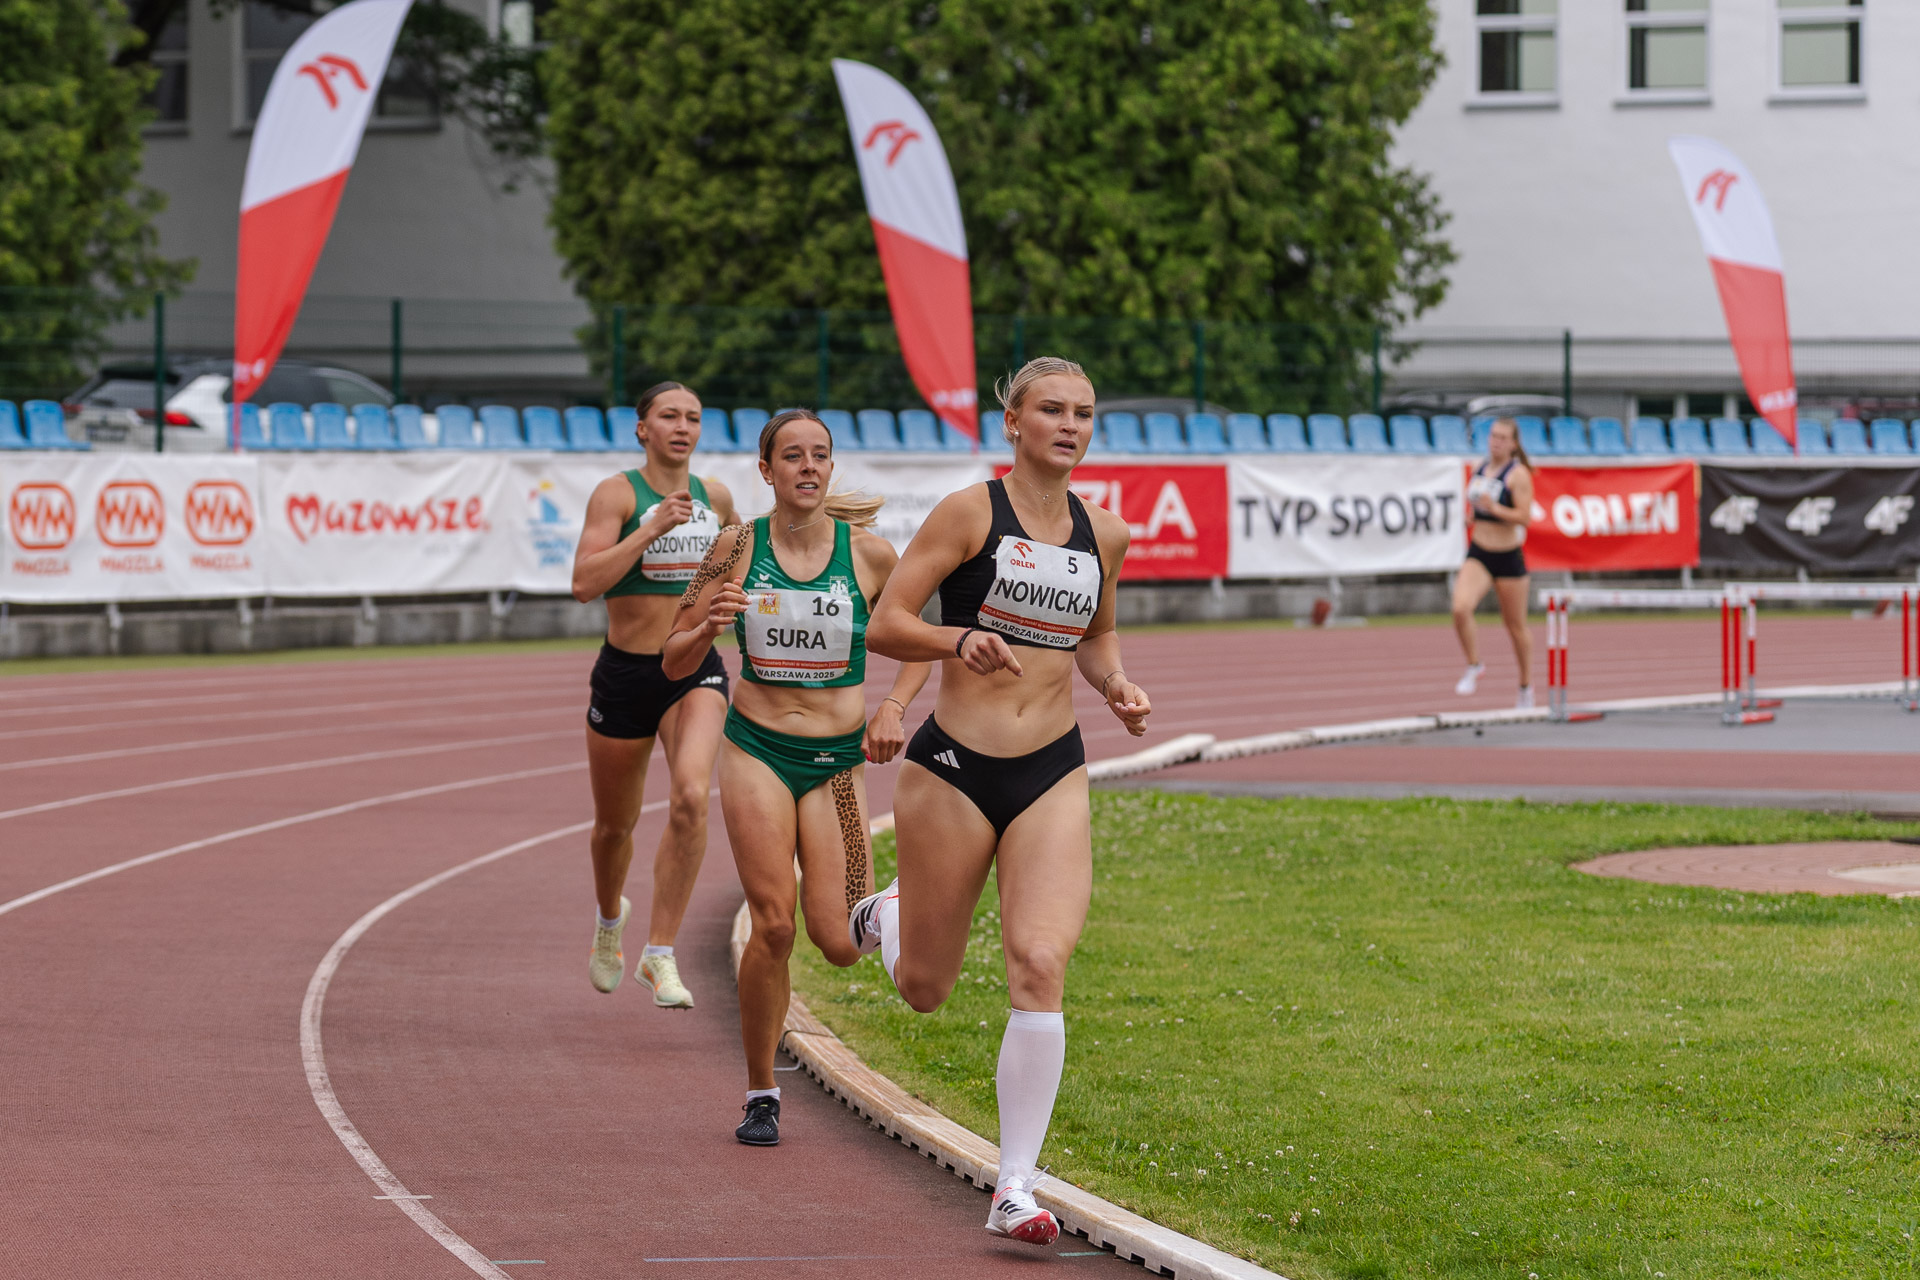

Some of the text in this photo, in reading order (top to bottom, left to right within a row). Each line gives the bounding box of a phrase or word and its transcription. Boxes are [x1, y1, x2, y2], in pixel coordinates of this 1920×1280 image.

[1236, 496, 1318, 537] TVP
[1329, 490, 1456, 536] SPORT
[1552, 490, 1679, 538] ORLEN
[1710, 495, 1759, 535] 4F
[1785, 496, 1836, 537] 4F
[1864, 495, 1915, 535] 4F
[1010, 558, 1036, 570] ORLEN
[1067, 555, 1079, 574] 5
[812, 596, 840, 617] 16
[994, 577, 1093, 616] NOWICKA
[765, 627, 827, 650] SURA
[991, 620, 1070, 645] WARSZAWA 2025
[756, 667, 835, 679] WARSZAWA 2025
